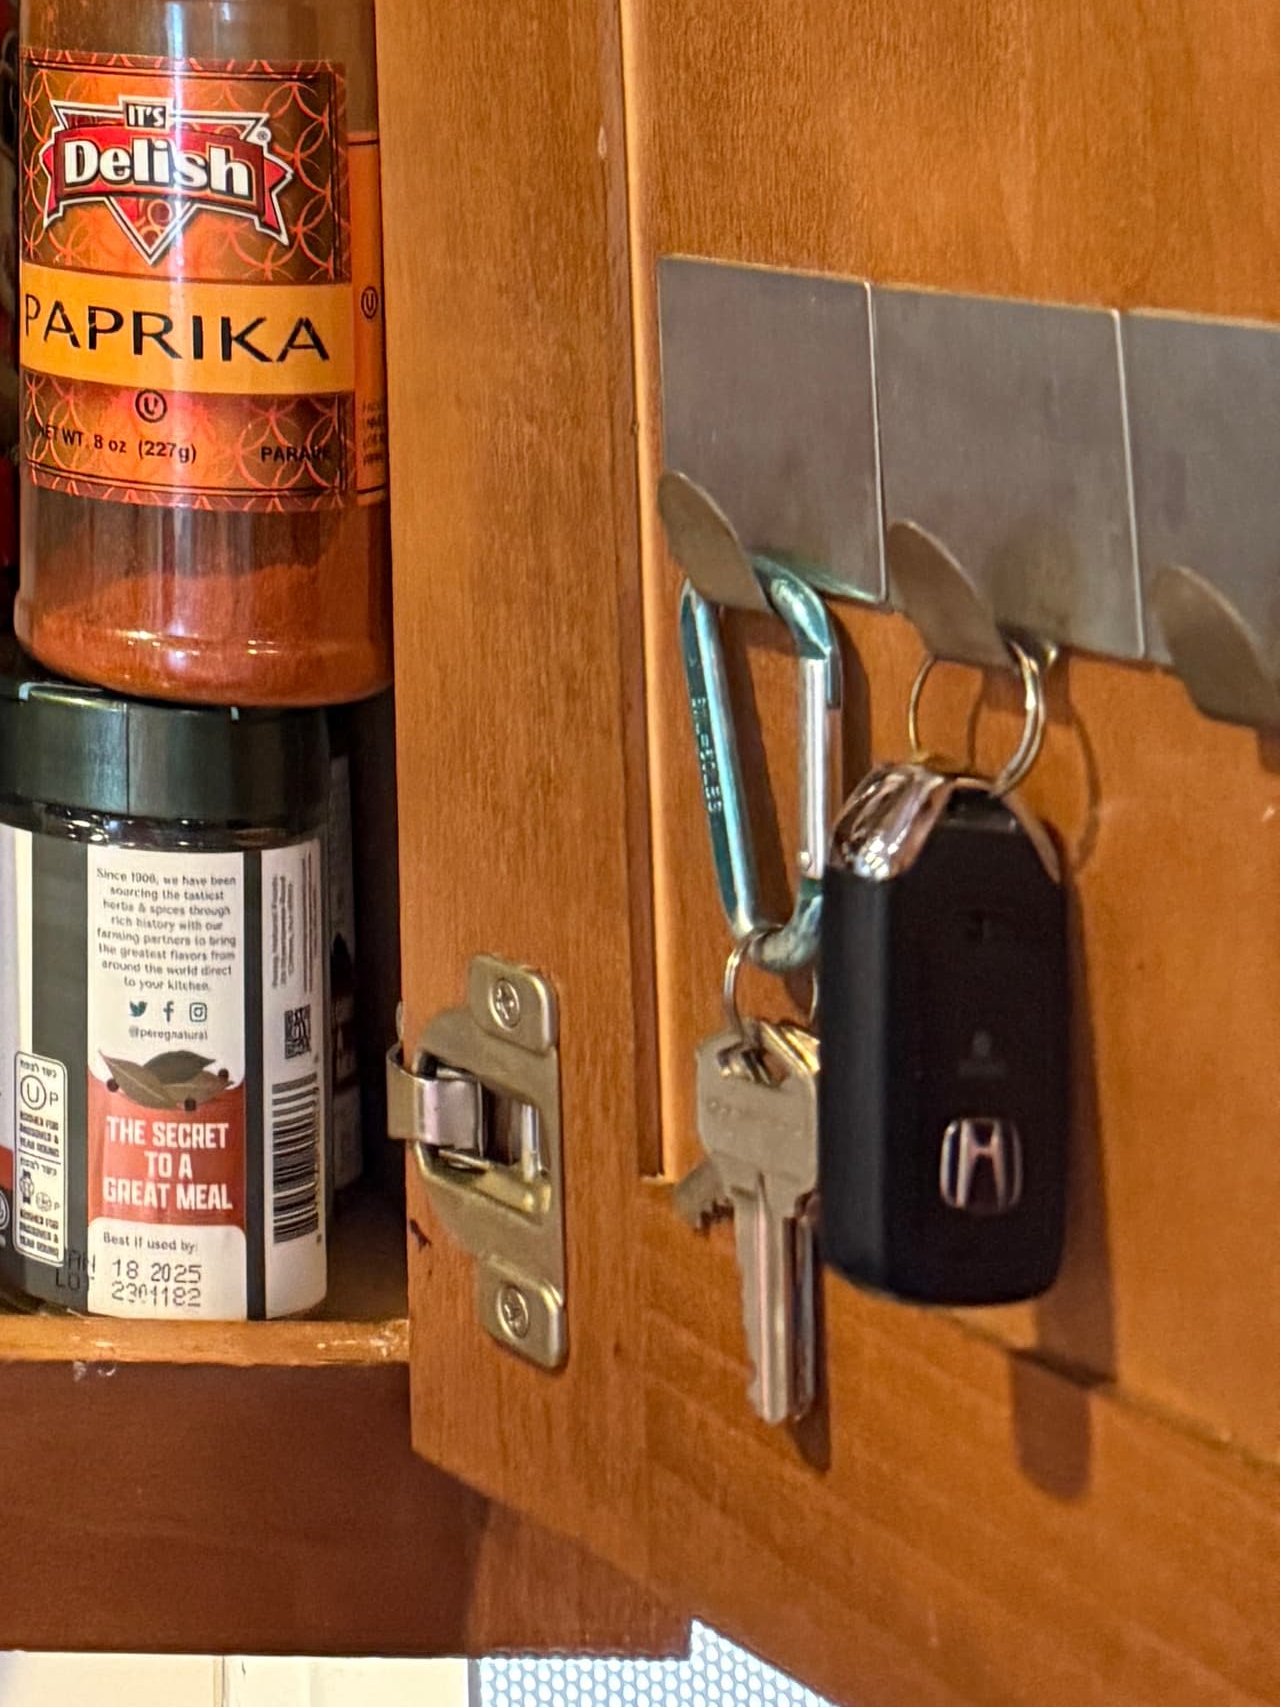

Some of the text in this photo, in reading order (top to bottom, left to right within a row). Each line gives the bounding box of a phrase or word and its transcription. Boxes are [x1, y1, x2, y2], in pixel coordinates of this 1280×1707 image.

[128, 103, 165, 127] IT'S
[63, 139, 251, 197] Delish
[25, 293, 328, 362] PAPRIKA
[138, 441, 196, 464] (227g)
[106, 1115, 229, 1149] THE SECRET
[144, 1150, 193, 1179] TO A
[103, 1176, 233, 1211] GREAT MEAL
[103, 1231, 130, 1247] Best
[147, 1236, 177, 1251] used
[112, 1258, 139, 1280] 18
[151, 1262, 203, 1284] 2025
